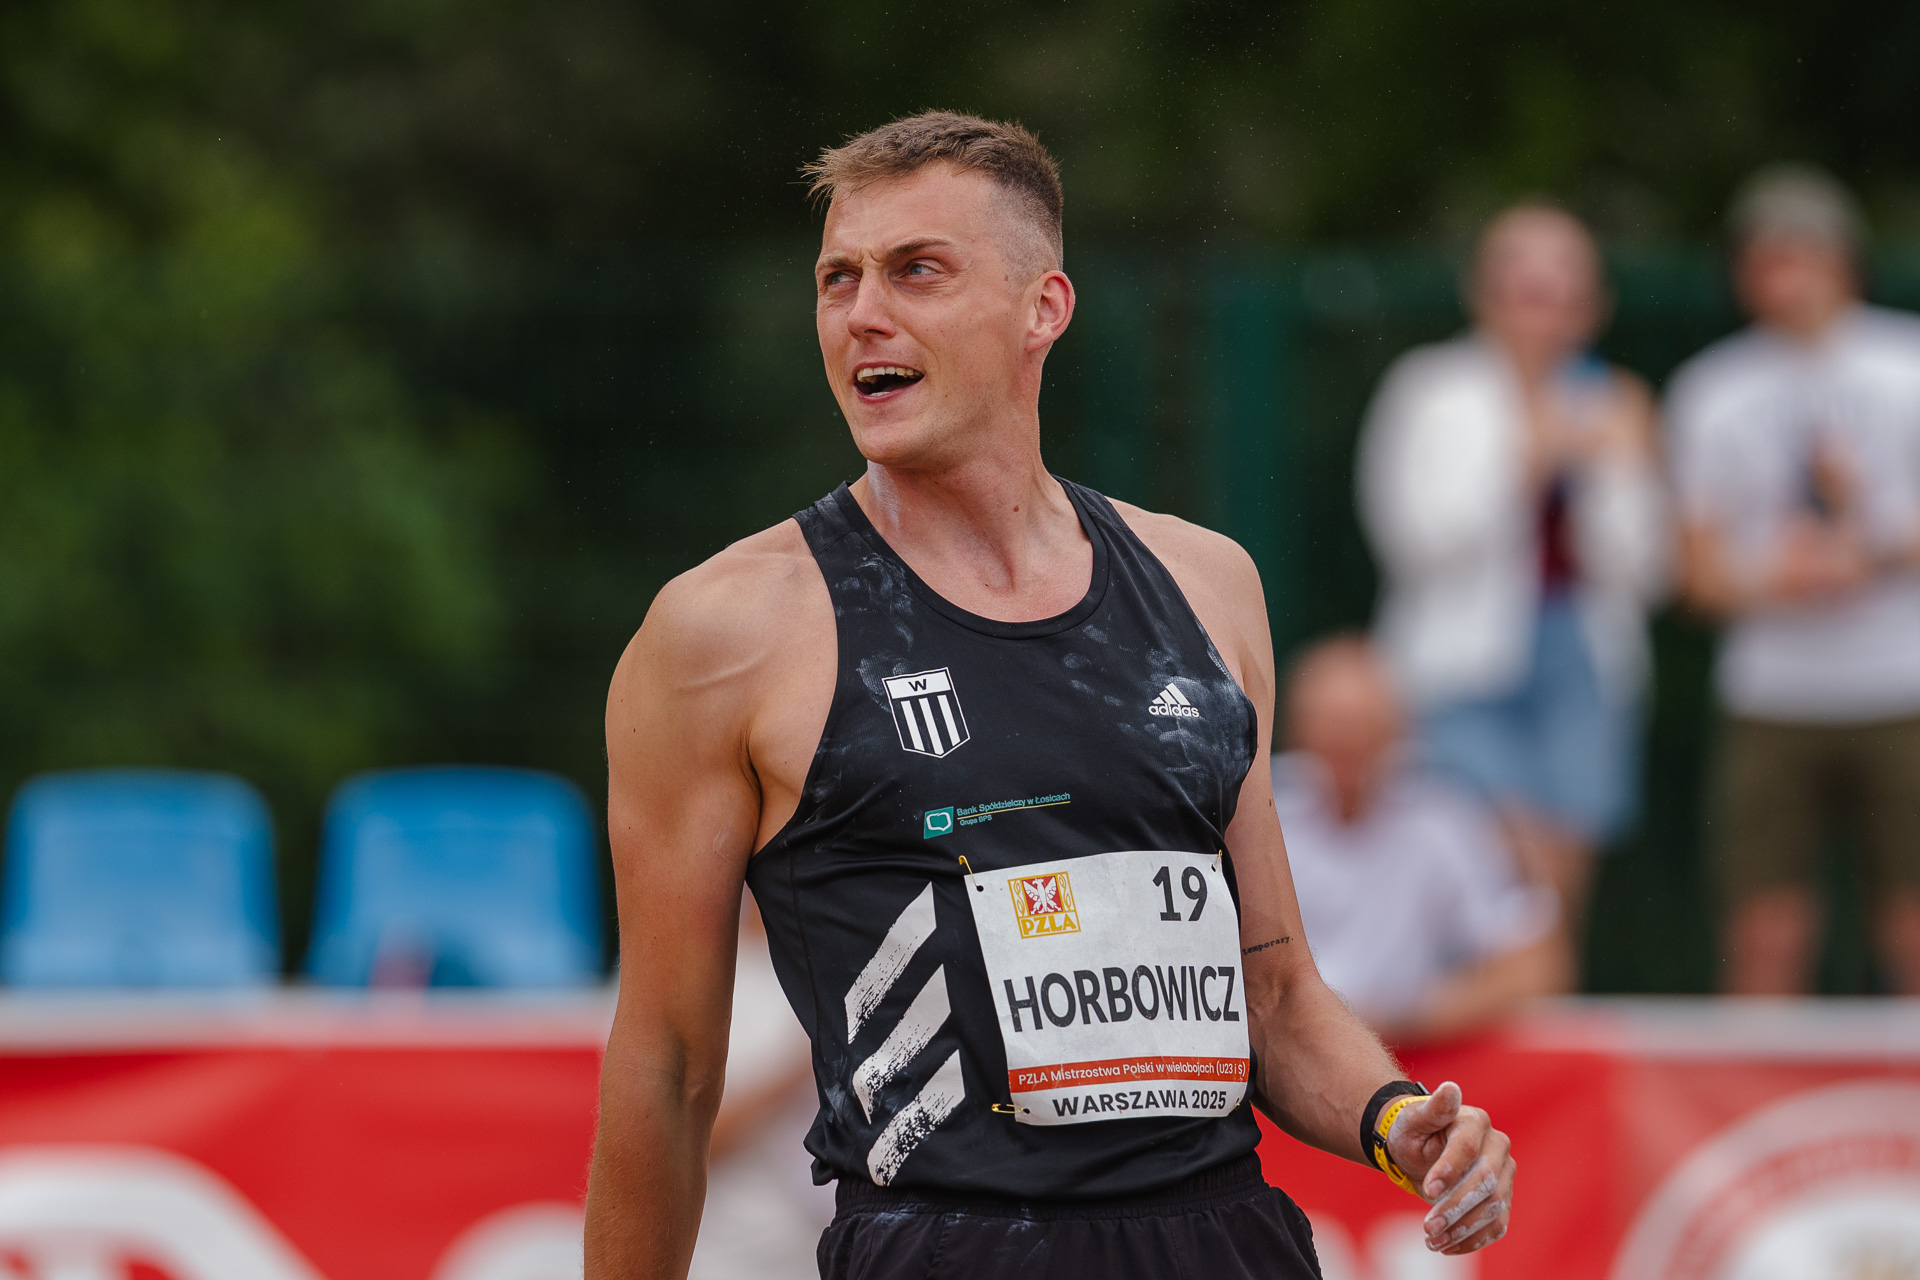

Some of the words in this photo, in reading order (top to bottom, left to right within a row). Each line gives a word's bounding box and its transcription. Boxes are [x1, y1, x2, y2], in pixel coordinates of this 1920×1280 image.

[909, 678, 927, 692] W
[1148, 703, 1200, 718] adidas
[957, 806, 978, 816] Bank
[979, 799, 1026, 812] Spółdzielczy
[1035, 792, 1071, 804] Łosicach
[960, 818, 978, 827] Grupa
[1152, 866, 1208, 922] 19
[1021, 913, 1077, 936] PZLA
[1003, 964, 1241, 1033] HORBOWICZ
[1018, 1073, 1048, 1086] PZLA
[1050, 1066, 1121, 1082] Mistrzostwa
[1122, 1061, 1155, 1075] Polski
[1155, 1064, 1166, 1073] w
[1166, 1062, 1215, 1076] wielobojach
[1216, 1060, 1234, 1075] (U23
[1052, 1089, 1188, 1117] WARSZAWA
[1191, 1090, 1227, 1110] 2025
